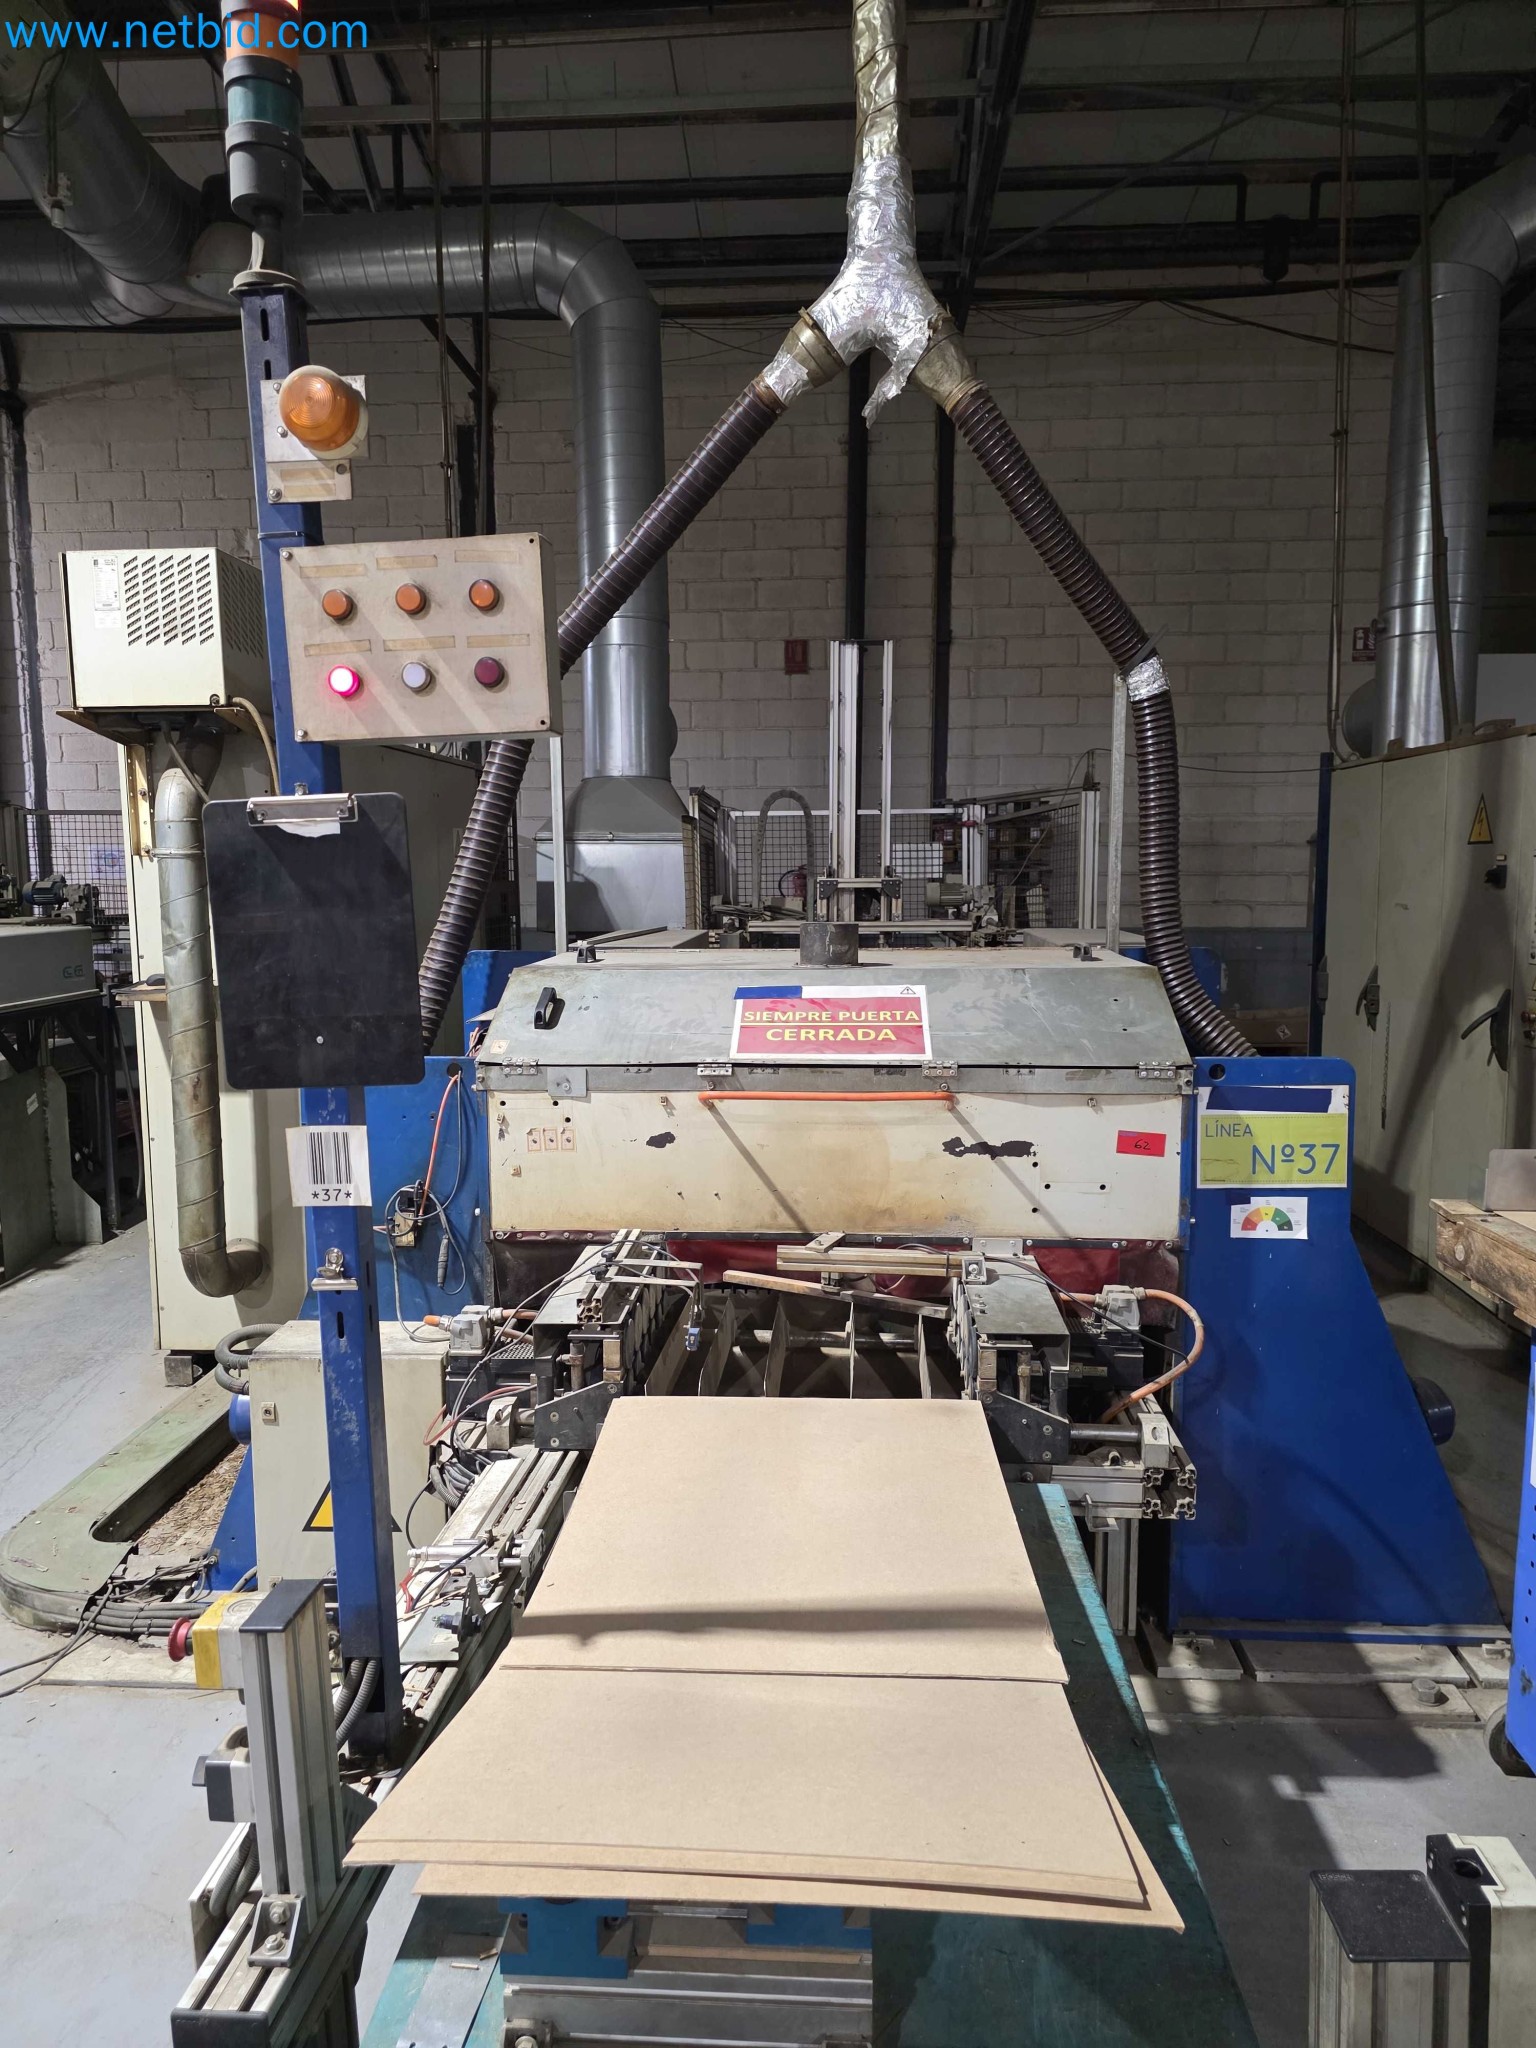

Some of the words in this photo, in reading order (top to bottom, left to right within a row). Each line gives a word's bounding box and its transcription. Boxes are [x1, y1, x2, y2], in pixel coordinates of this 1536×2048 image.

[743, 1010, 832, 1022] SIEMPRE
[838, 1009, 920, 1021] PUERTA
[765, 1028, 898, 1041] CERRADA
[1205, 1119, 1254, 1138] LÍNEA
[1133, 1138, 1152, 1151] 62
